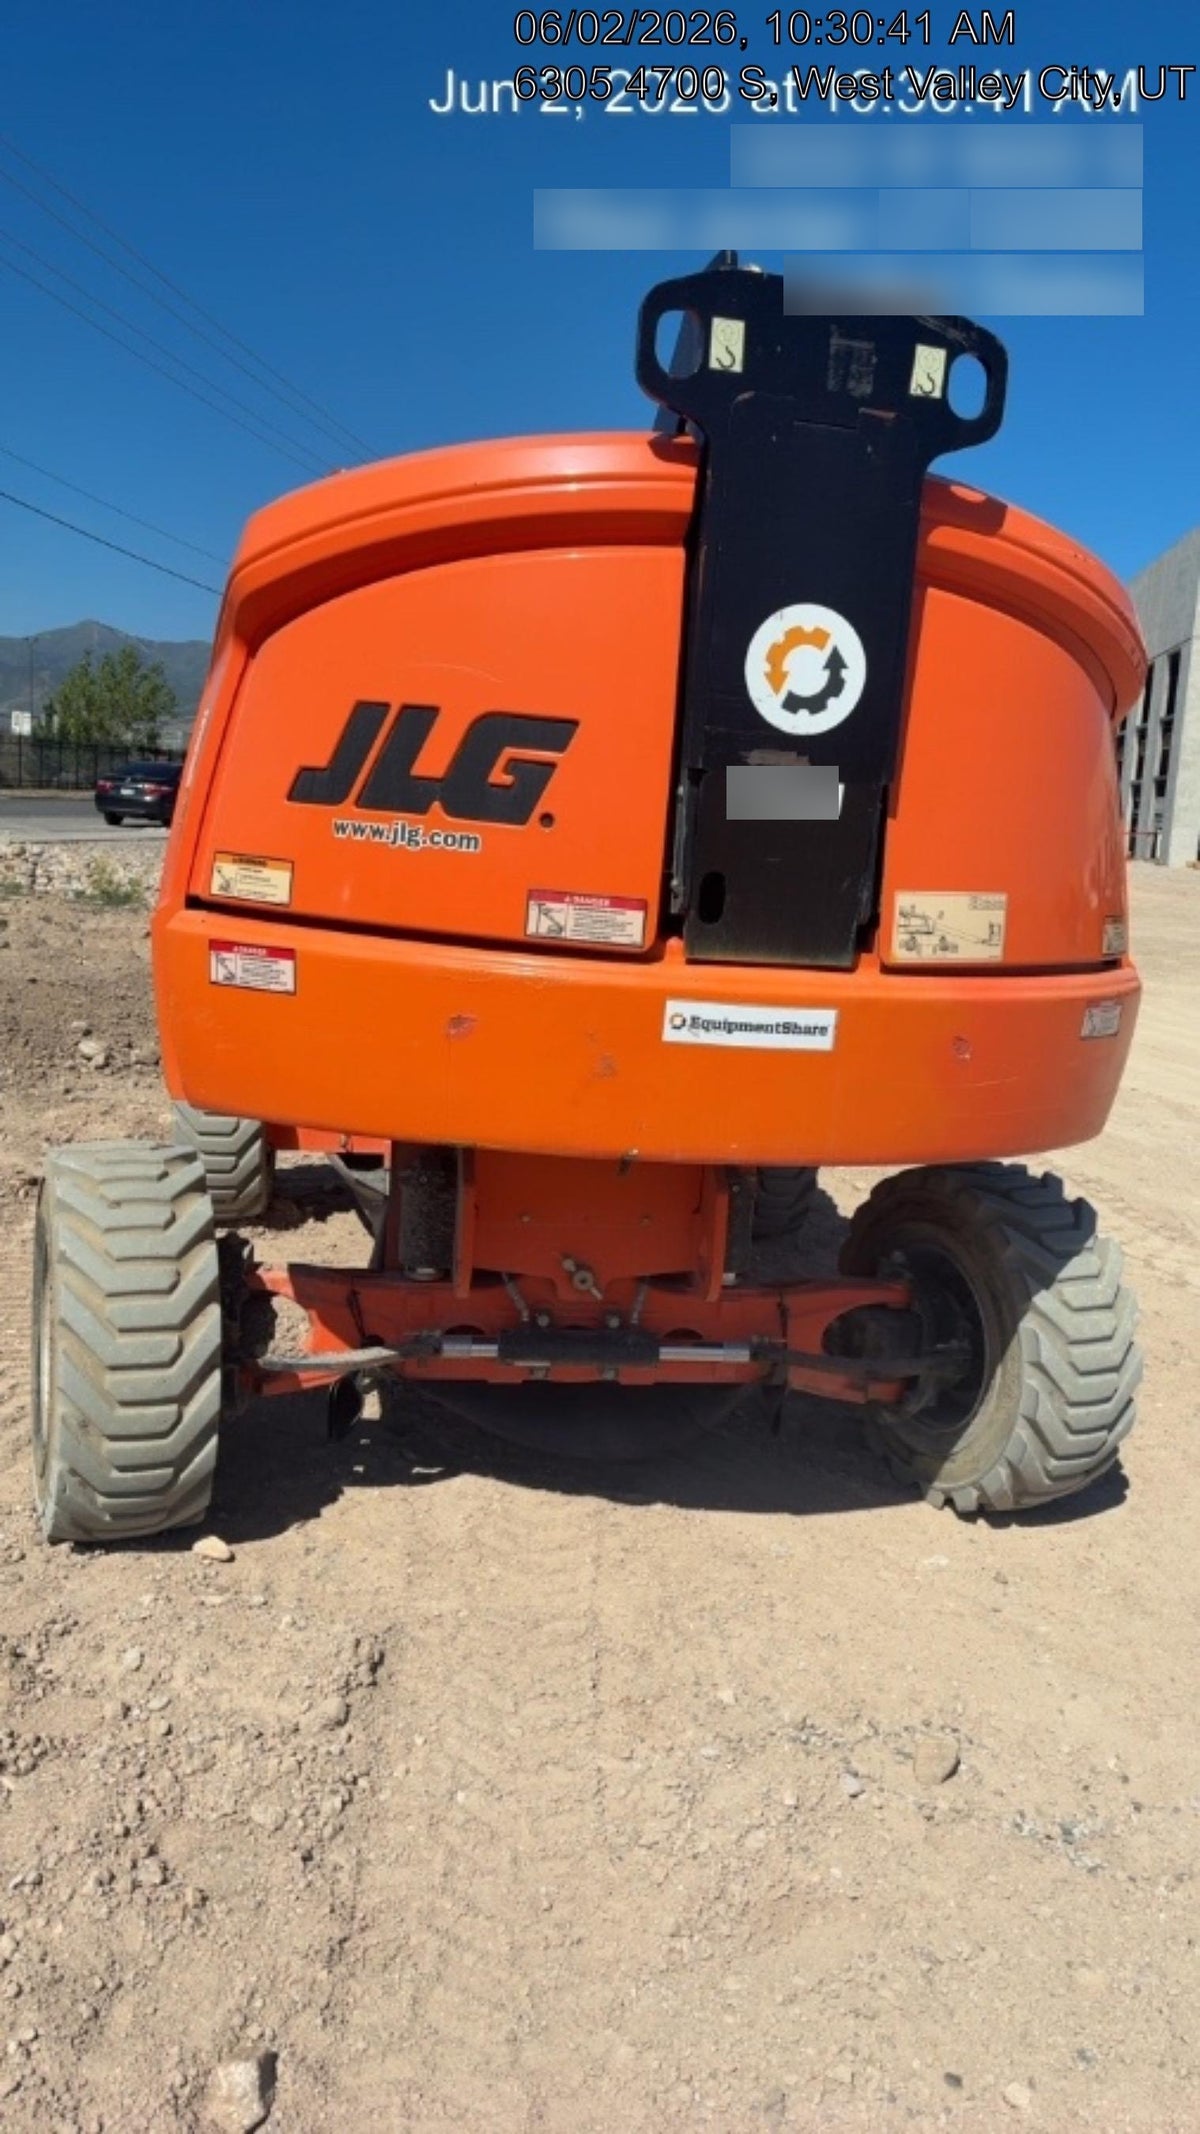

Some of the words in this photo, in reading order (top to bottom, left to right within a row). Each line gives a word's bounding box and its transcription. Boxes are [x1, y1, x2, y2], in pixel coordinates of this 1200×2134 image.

[286, 700, 580, 826] JLG
[332, 819, 482, 852] www.jlg.com
[689, 1014, 830, 1037] EquipmentShare
